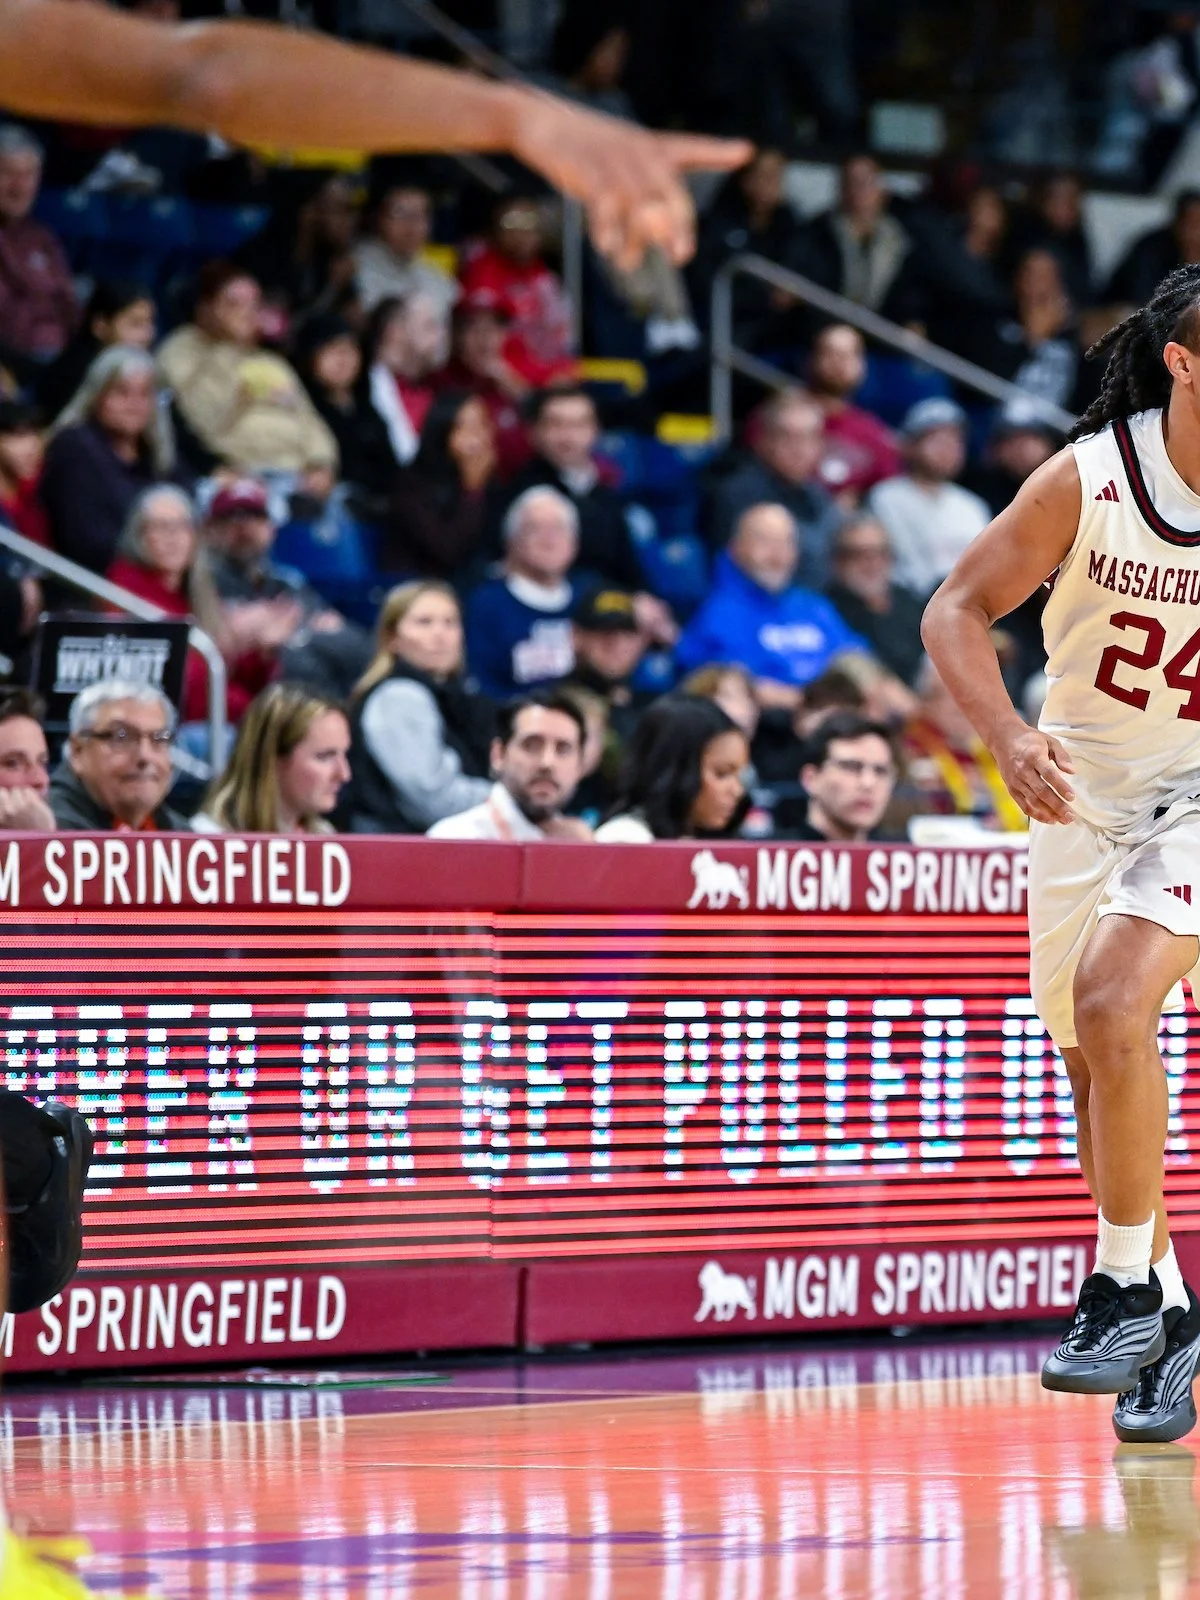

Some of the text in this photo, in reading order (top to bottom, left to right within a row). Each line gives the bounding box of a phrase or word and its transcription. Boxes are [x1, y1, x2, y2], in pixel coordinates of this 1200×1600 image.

[43, 838, 351, 907] SPRINGFIELD
[756, 847, 851, 911] MGM
[36, 1275, 347, 1356] SPRINGFIELD
[763, 1253, 860, 1321] MGM
